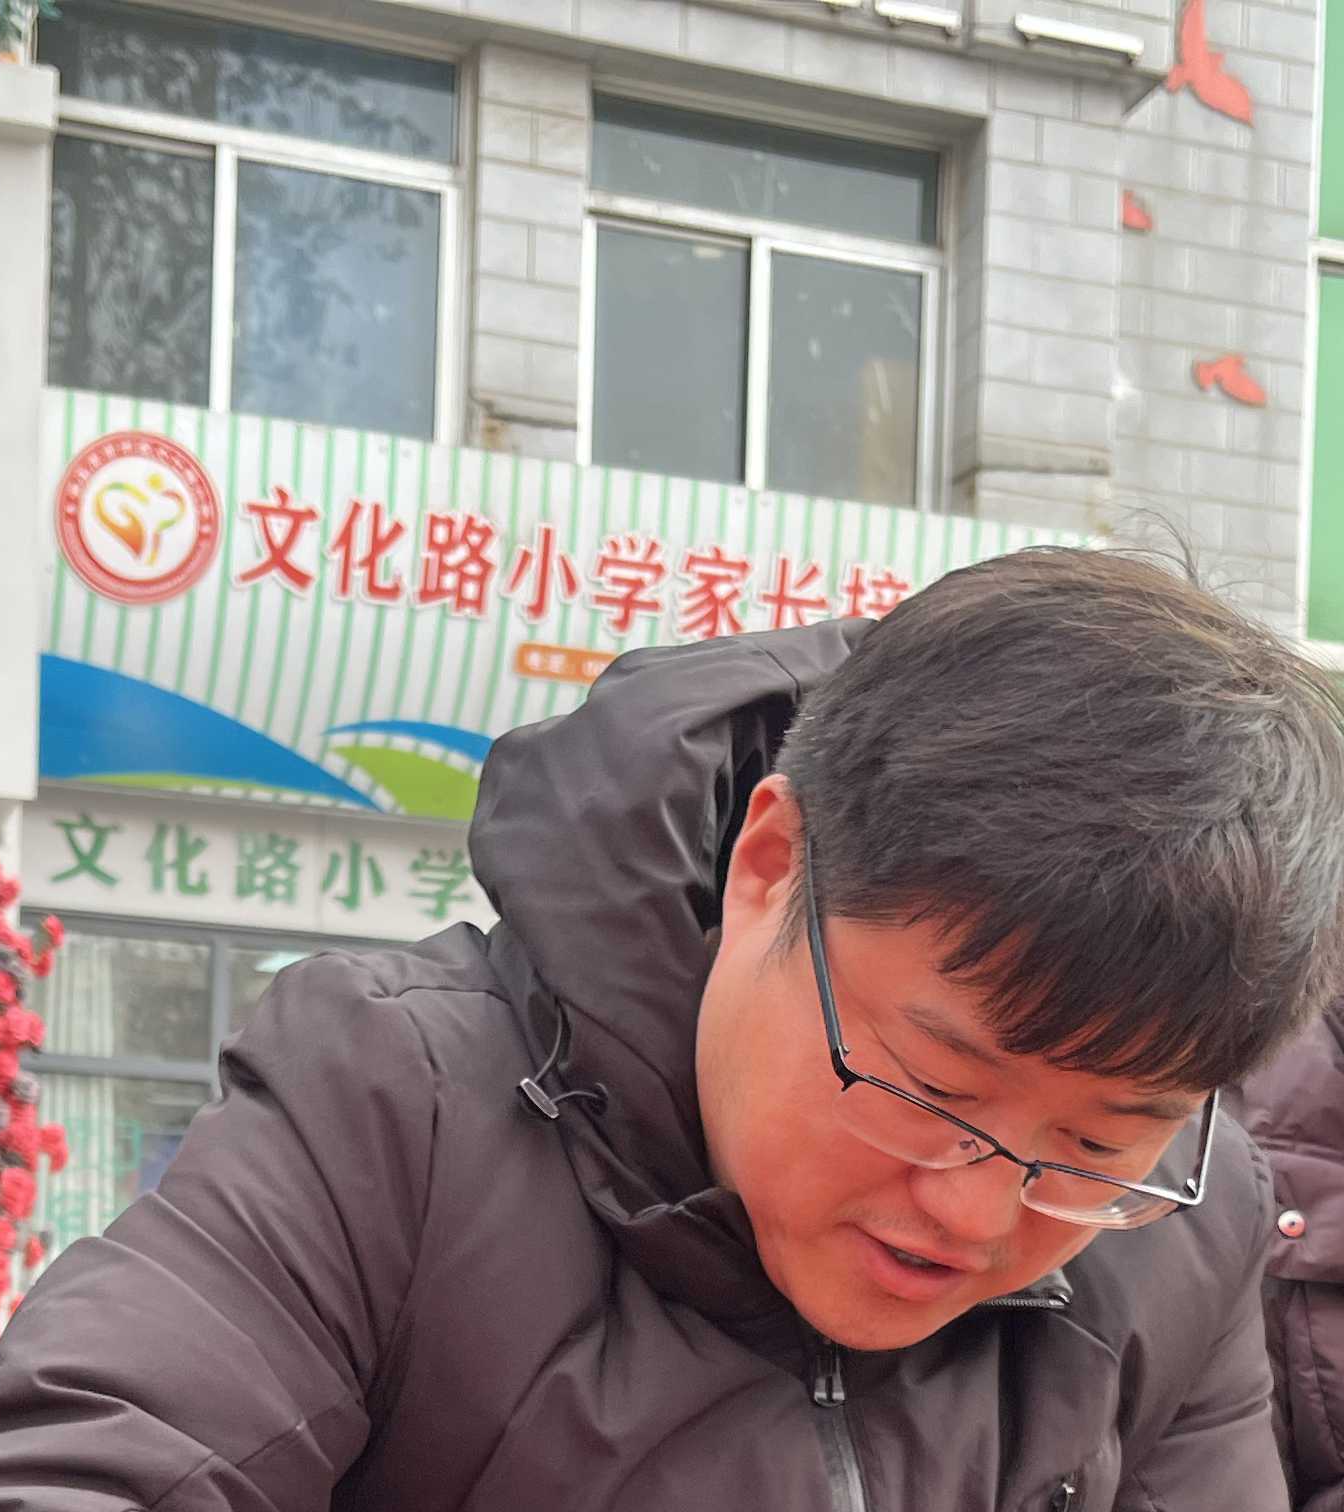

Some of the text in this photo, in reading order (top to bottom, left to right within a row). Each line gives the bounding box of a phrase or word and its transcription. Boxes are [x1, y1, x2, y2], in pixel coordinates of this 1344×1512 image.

[52, 813, 473, 920] 文化路小学
